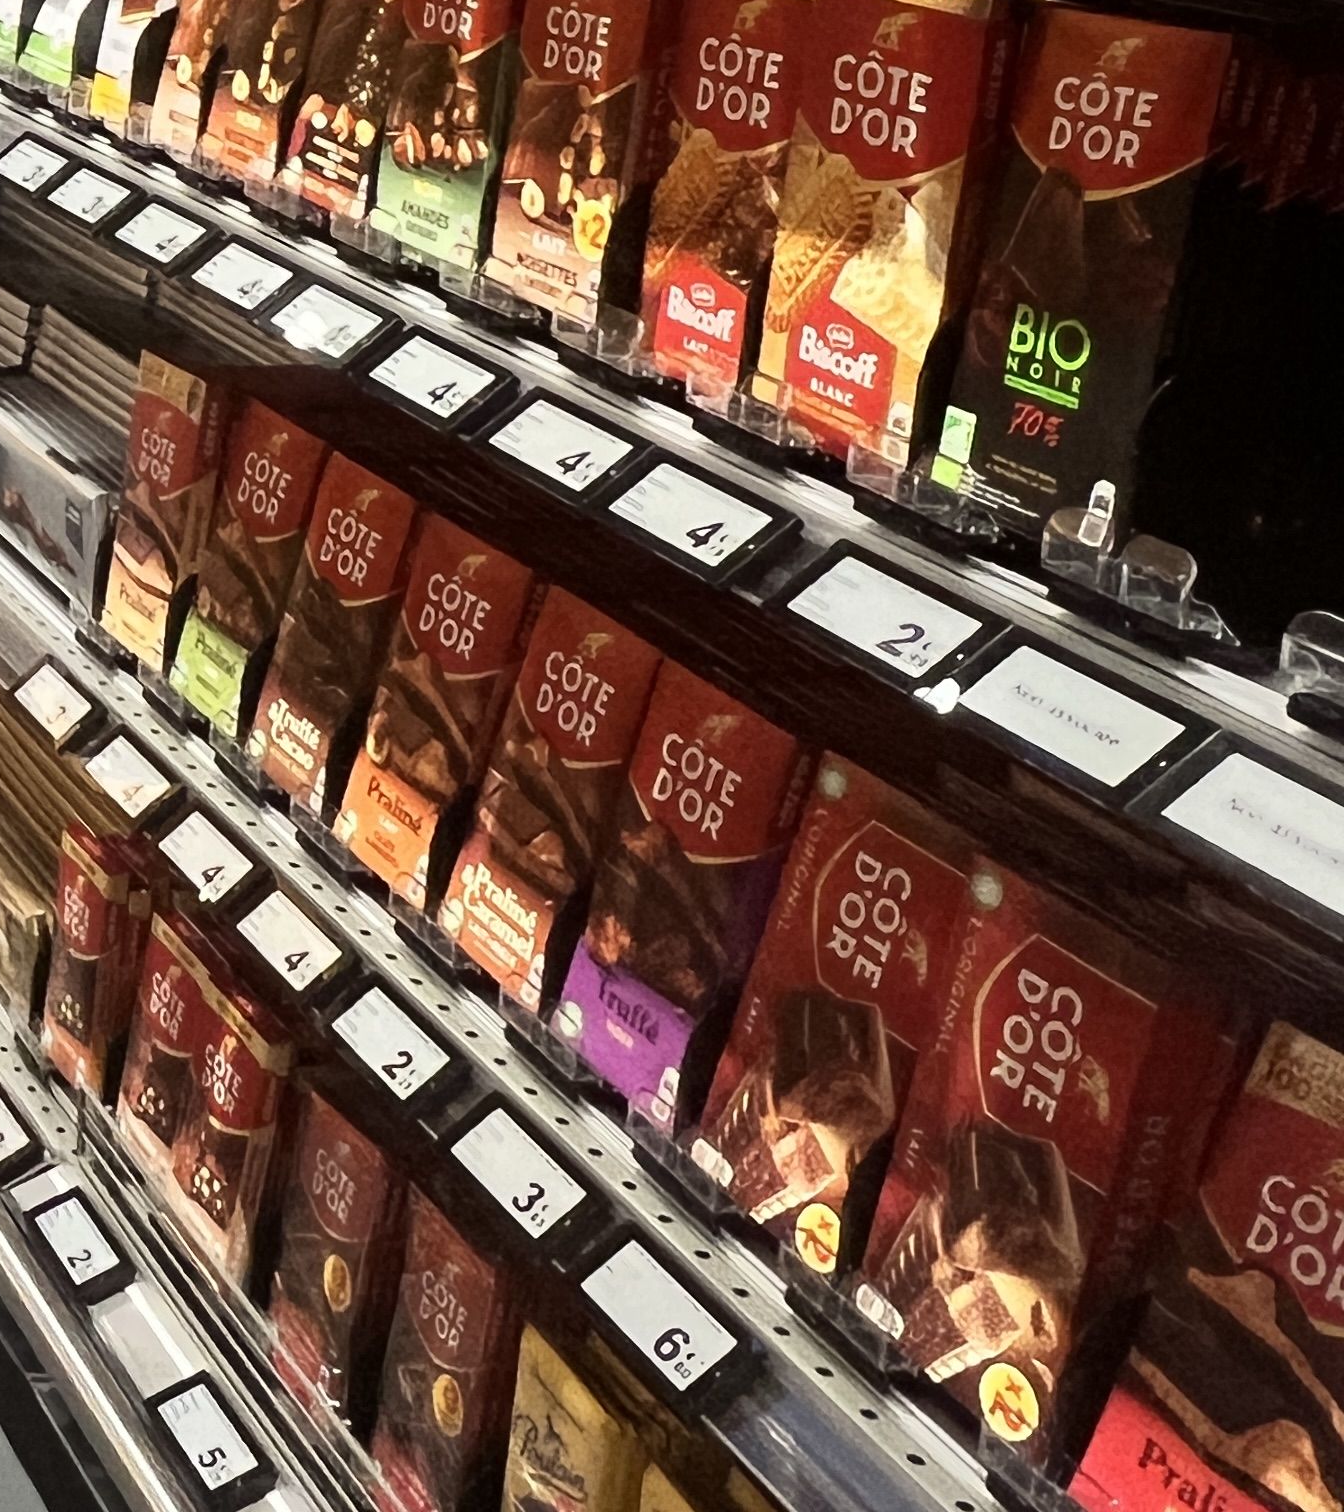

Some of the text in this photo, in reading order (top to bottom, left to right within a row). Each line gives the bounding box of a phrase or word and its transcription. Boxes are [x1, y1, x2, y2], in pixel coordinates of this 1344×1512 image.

[422, 1, 473, 41] D'OR
[546, 1, 612, 47] CÔTE
[542, 38, 604, 81] D'OR
[698, 32, 783, 90] CÔTE
[833, 49, 933, 114] CÔTE
[695, 82, 771, 129] D'OR
[830, 97, 918, 158] D'OR
[1053, 72, 1160, 128] CÔTE
[1048, 115, 1141, 170] D'OR
[666, 285, 736, 343] Biscoff
[1010, 303, 1092, 370] BIO
[799, 324, 880, 390] Biscoff
[1006, 356, 1082, 394] NOIR
[810, 377, 856, 408] BLANC
[237, 477, 279, 524] D'OR
[244, 452, 293, 499] CÔTE
[319, 535, 368, 587] D'OR
[327, 508, 383, 560] CÔTE
[427, 573, 491, 631] CÔTE
[418, 604, 475, 661] D'OR
[545, 651, 615, 716] CÔTE
[536, 683, 598, 747] D'OR
[662, 732, 742, 808] CÔTE
[368, 775, 423, 838] Praliné
[651, 767, 724, 841] D'OR
[464, 862, 538, 930] Praliné
[826, 850, 883, 960] D'OR
[466, 888, 534, 963] Caramel
[852, 866, 912, 989] CÔTE
[990, 968, 1049, 1089] D'OR
[1022, 986, 1084, 1124] CÔTE
[381, 1050, 414, 1080] 2
[67, 1248, 92, 1270] 2
[653, 1327, 691, 1363] 6
[198, 1446, 227, 1468] 5
